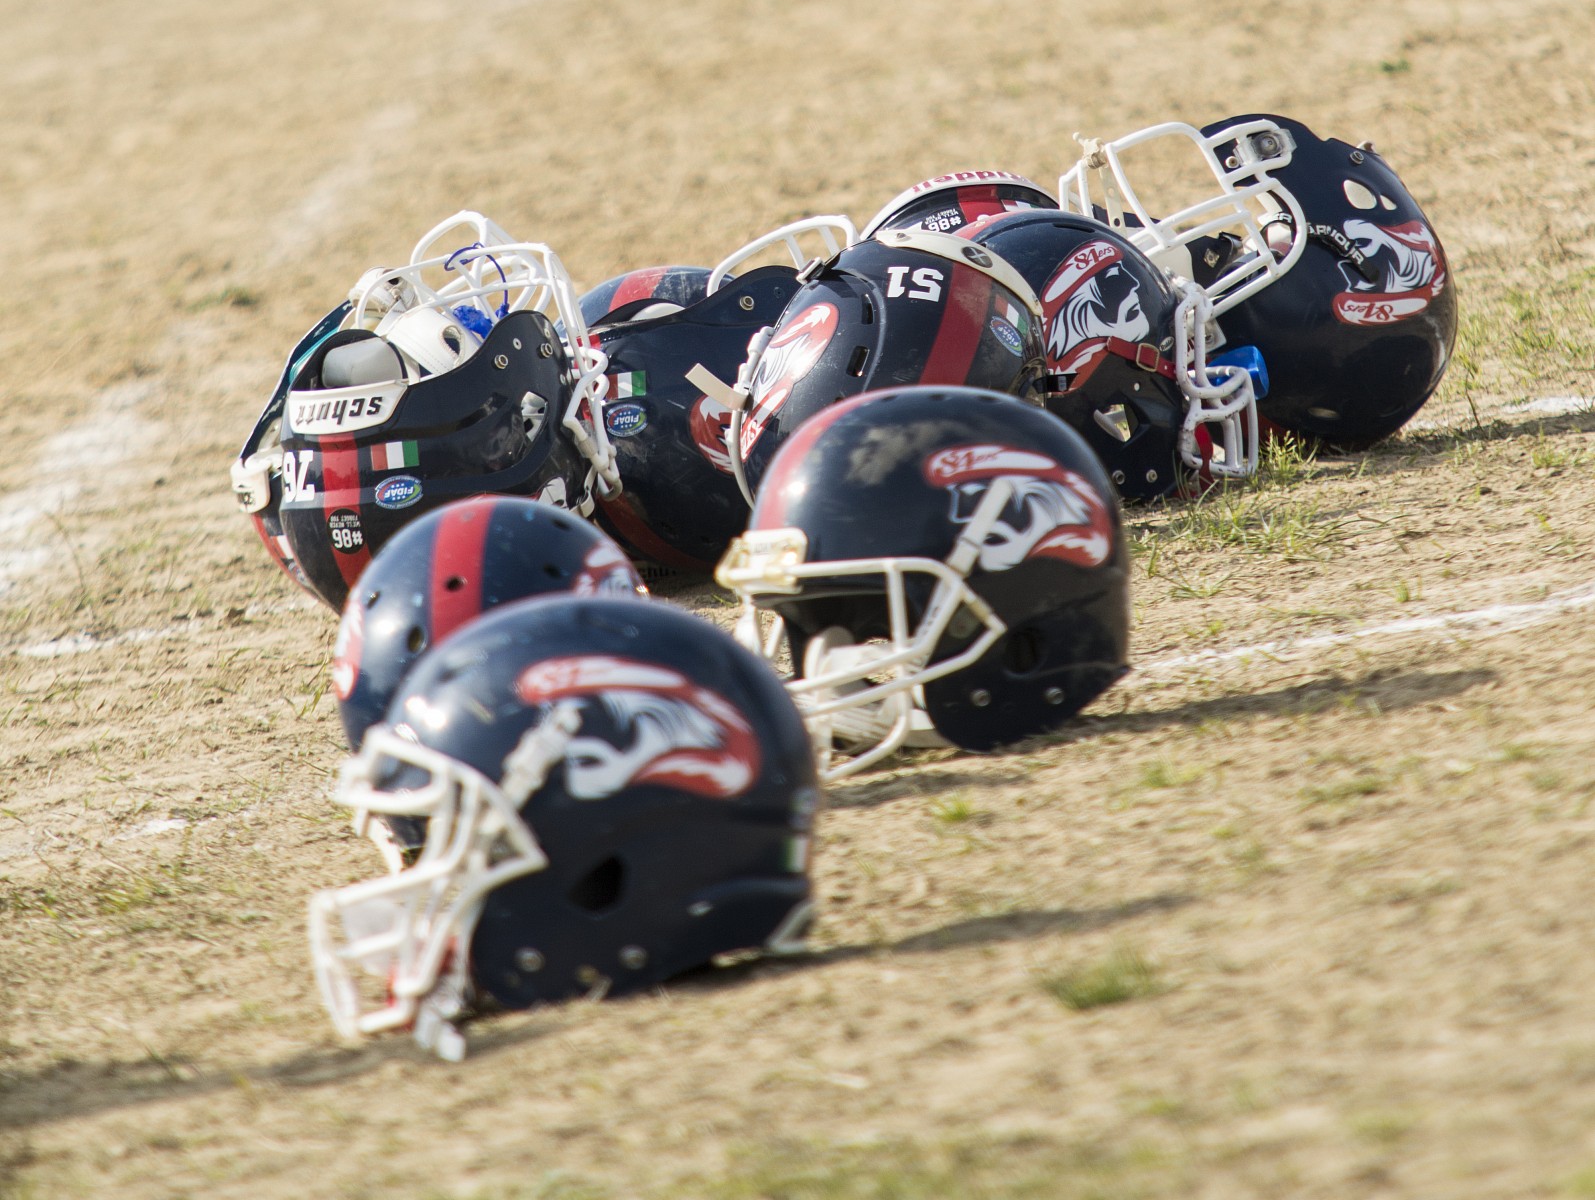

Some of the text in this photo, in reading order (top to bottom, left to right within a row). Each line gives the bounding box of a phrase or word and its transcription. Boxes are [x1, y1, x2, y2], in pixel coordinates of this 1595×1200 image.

[928, 215, 962, 232] #86
[887, 266, 944, 303] 51
[613, 414, 640, 426] FIDAF
[283, 449, 316, 503] 76
[383, 485, 415, 499] FIDAF
[332, 528, 364, 549] #86
